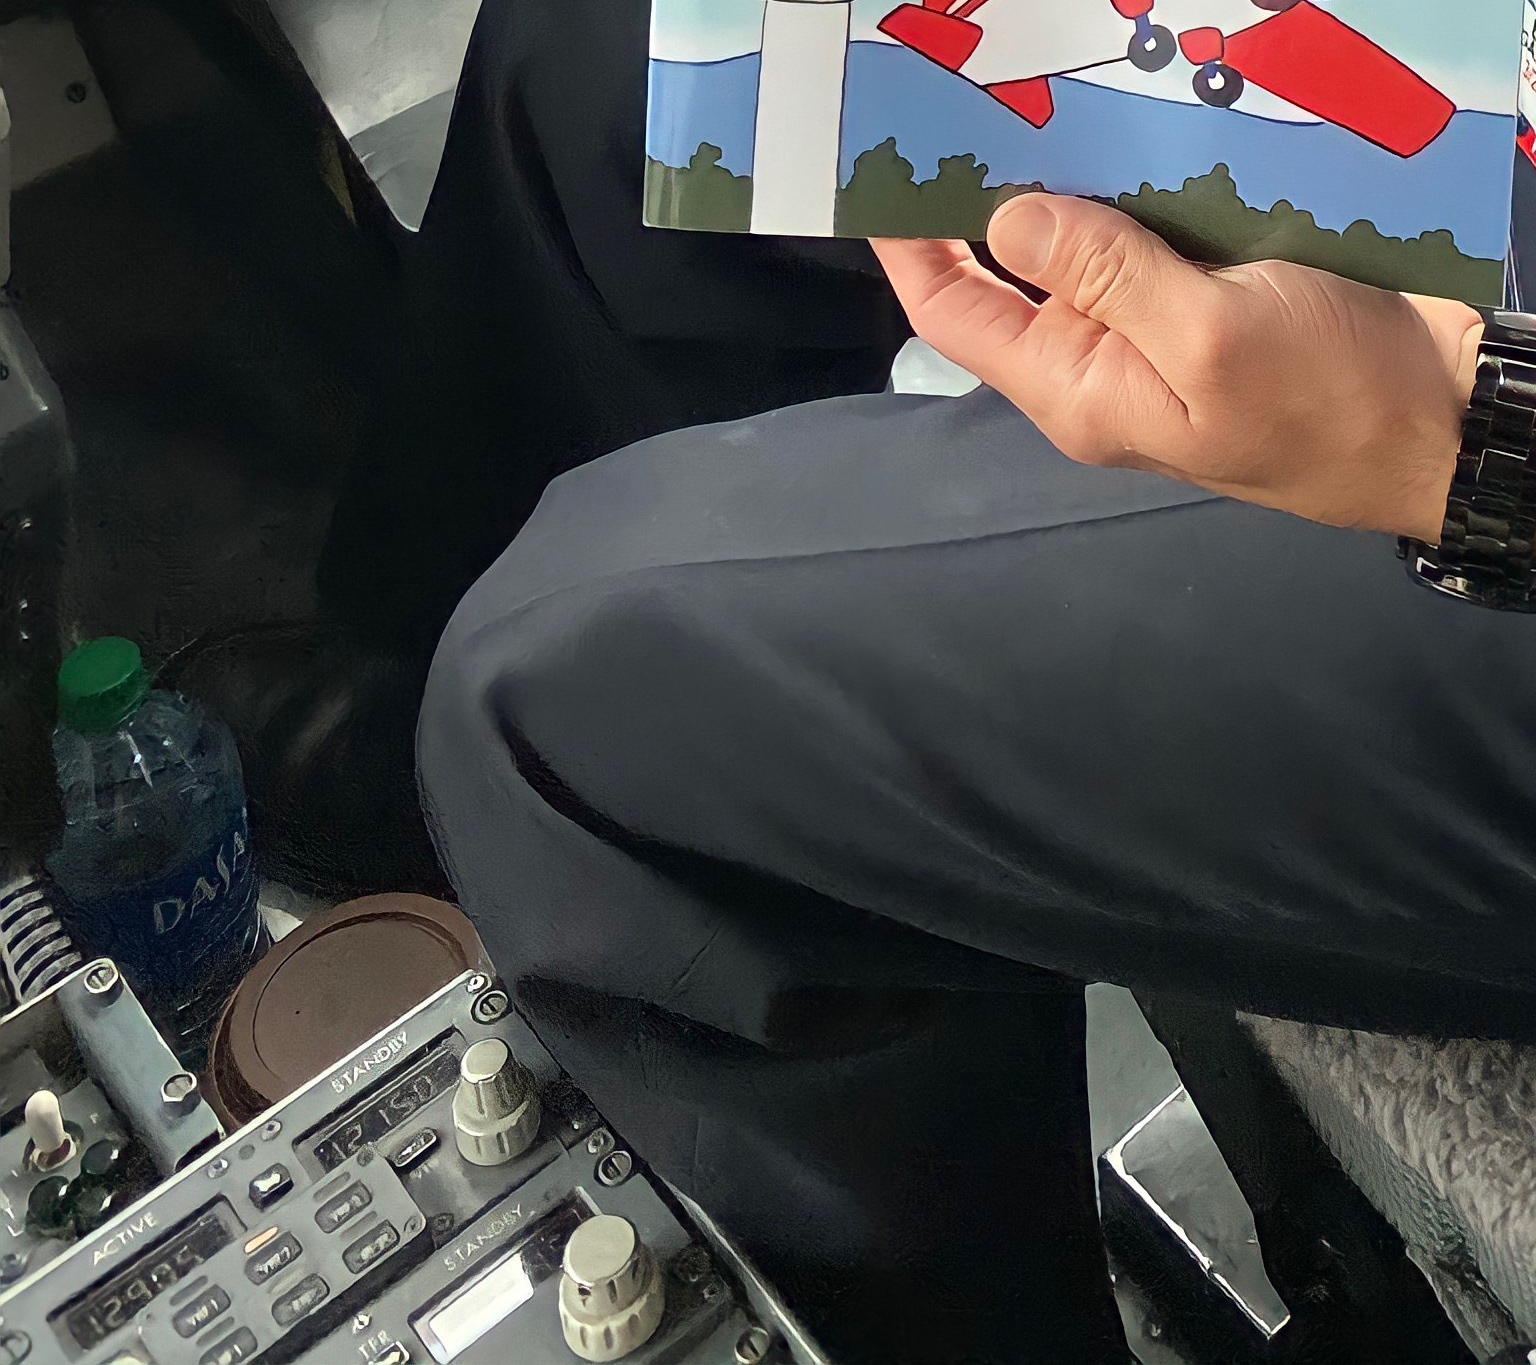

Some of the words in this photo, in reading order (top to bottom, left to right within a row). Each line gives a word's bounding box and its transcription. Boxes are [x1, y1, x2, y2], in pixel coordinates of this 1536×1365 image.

[330, 1031, 408, 1096] STANDBY
[93, 1211, 157, 1267] ACTIVE
[444, 1203, 522, 1271] STANDBY
